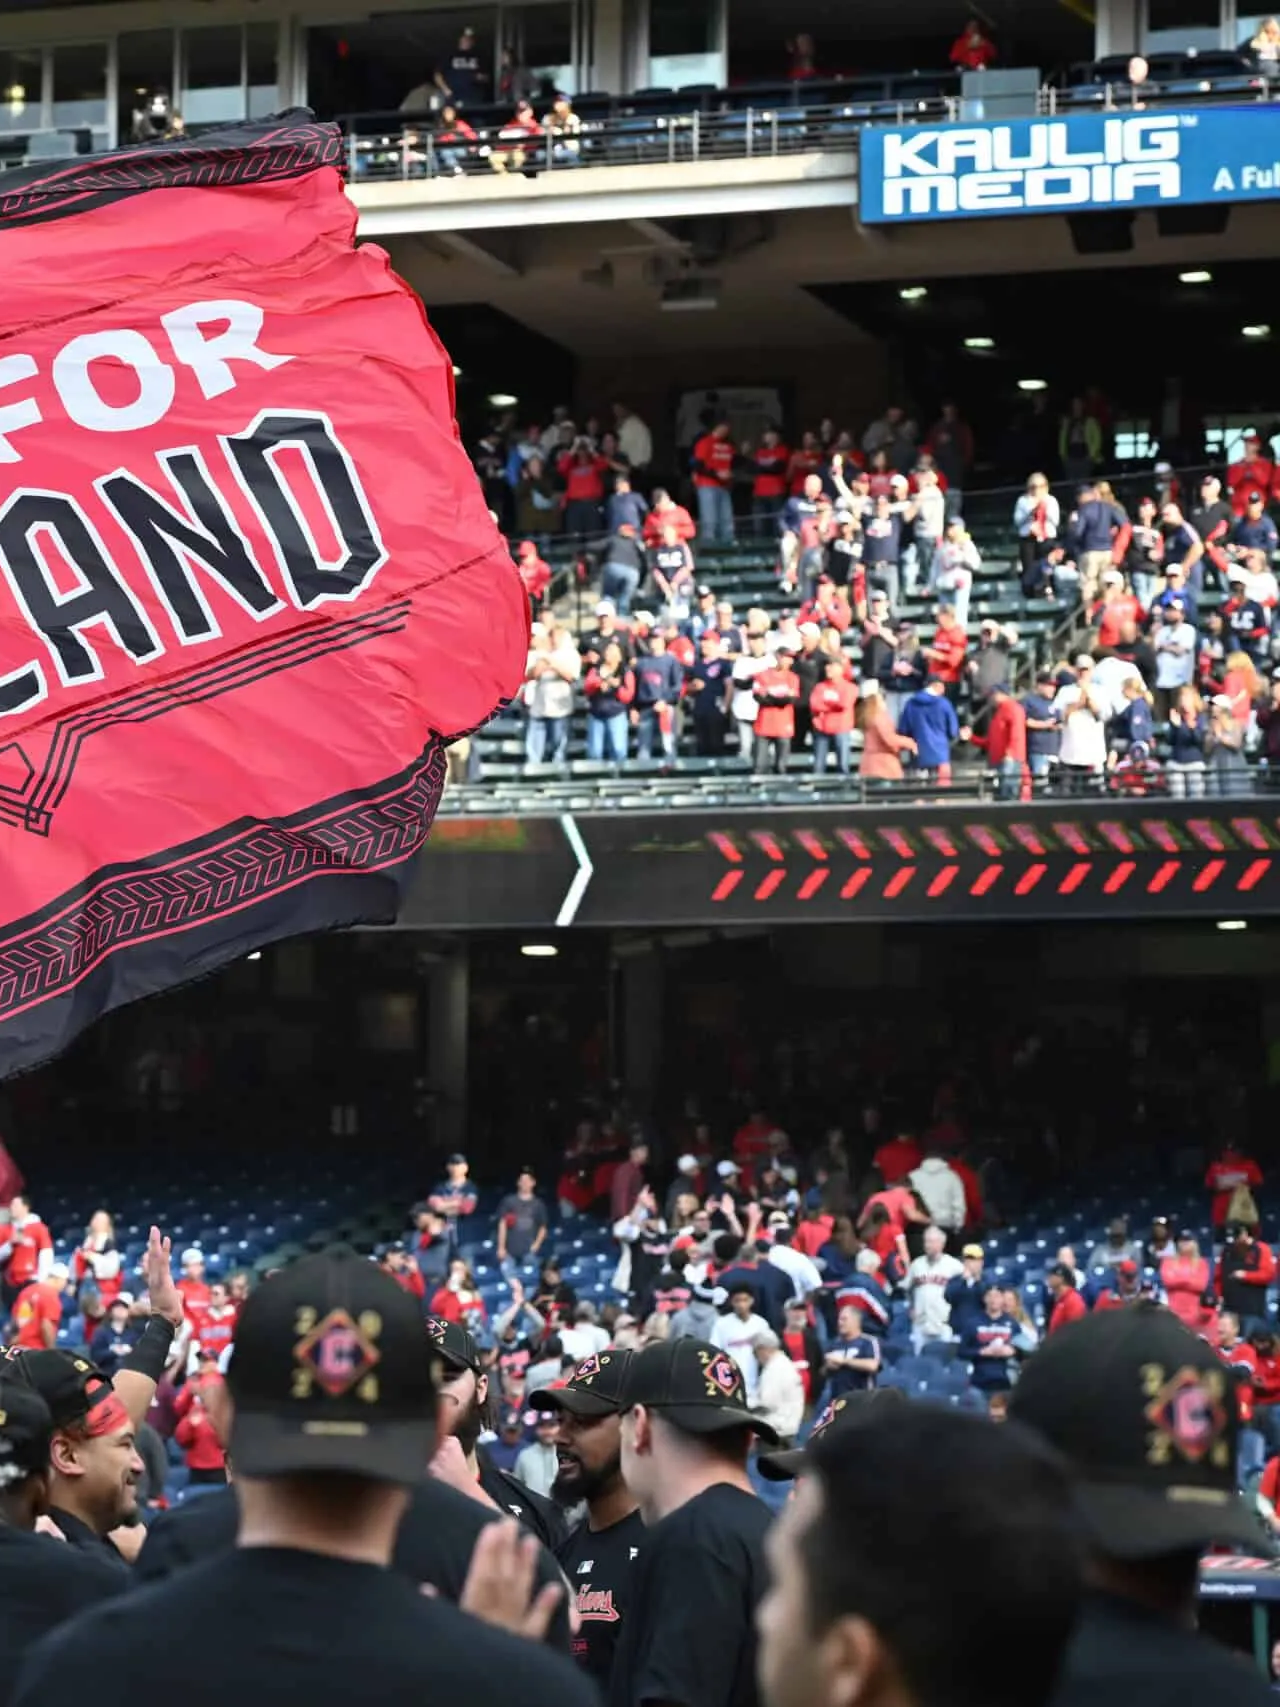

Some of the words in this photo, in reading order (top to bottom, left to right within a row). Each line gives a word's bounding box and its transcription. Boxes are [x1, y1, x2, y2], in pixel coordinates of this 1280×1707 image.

[882, 114, 1180, 177] KAULIG
[882, 160, 1181, 215] MEDIA
[1213, 166, 1235, 192] A
[716, 1362, 733, 1386] C
